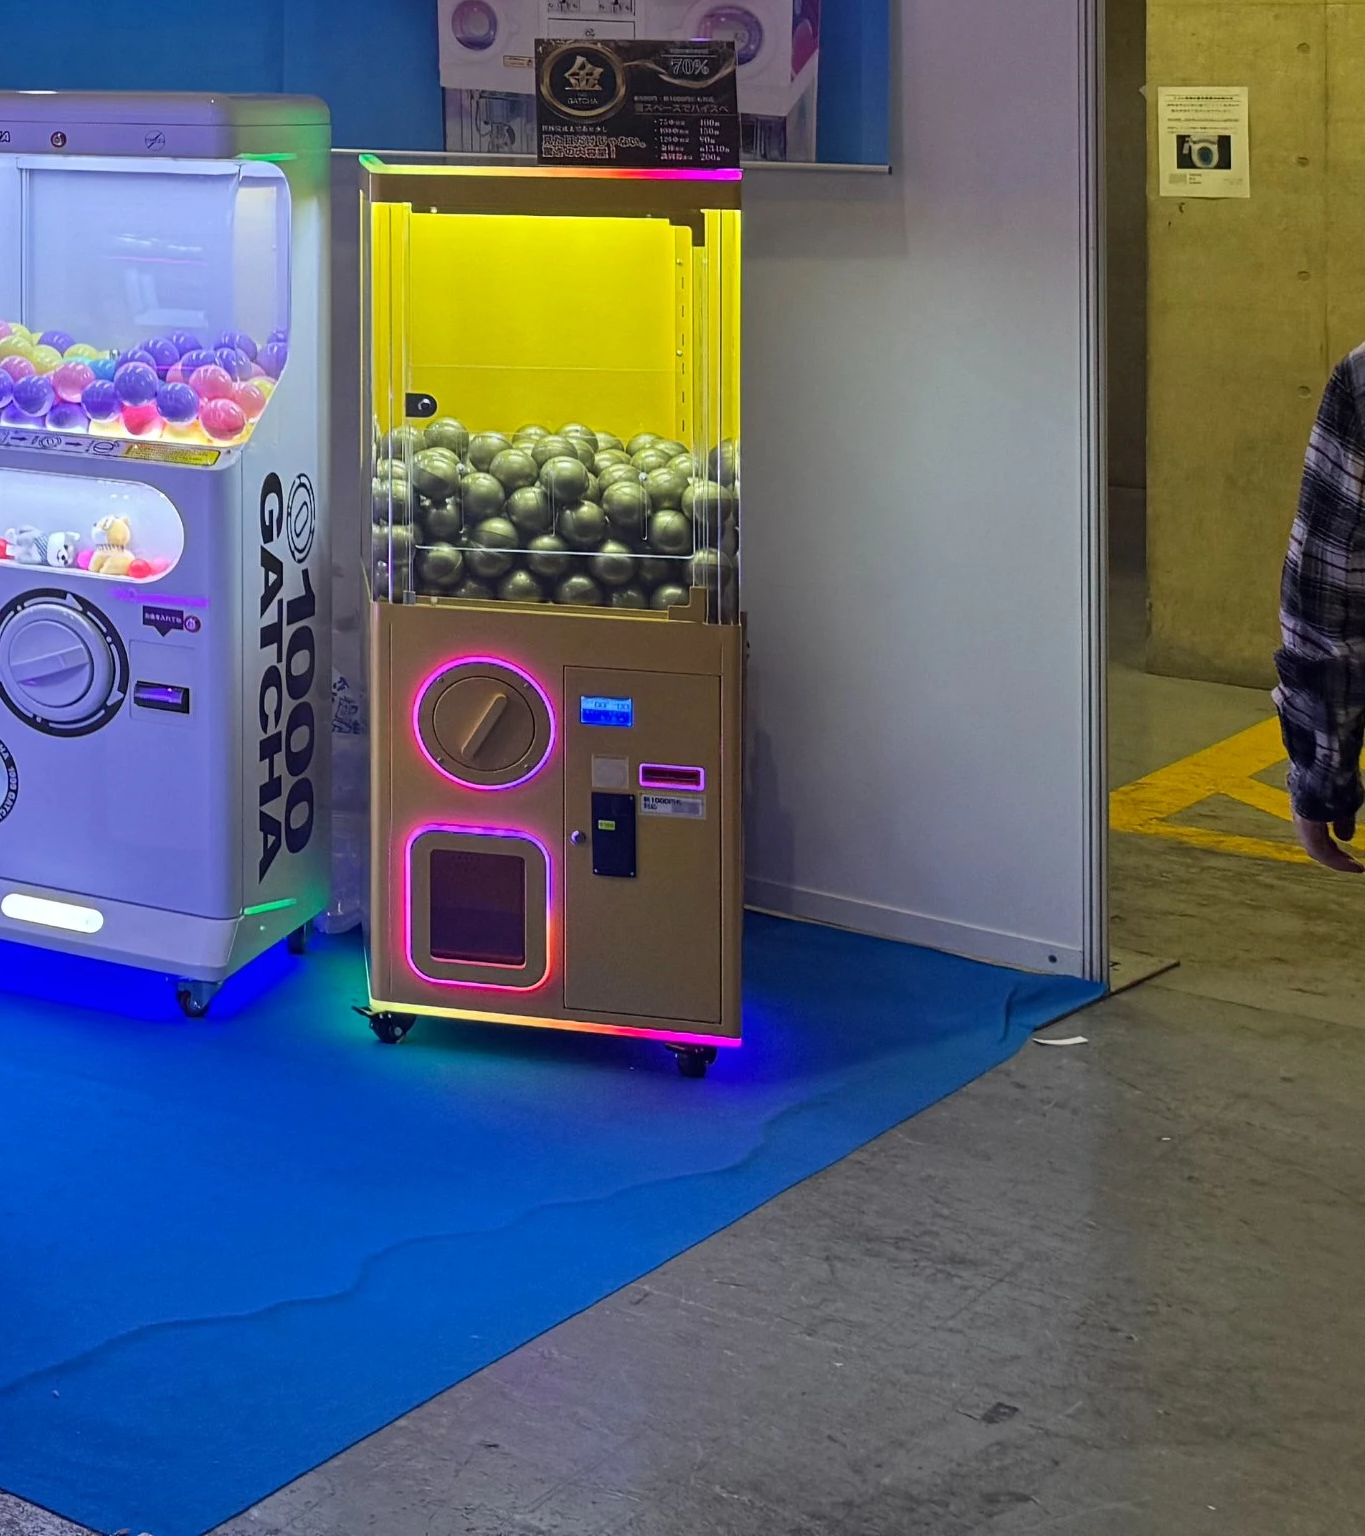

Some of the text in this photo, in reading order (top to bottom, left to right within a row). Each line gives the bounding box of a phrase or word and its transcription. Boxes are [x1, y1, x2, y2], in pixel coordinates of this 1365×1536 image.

[671, 58, 711, 76] 70%
[258, 471, 285, 885] GATCHA
[285, 567, 316, 854] 1000
